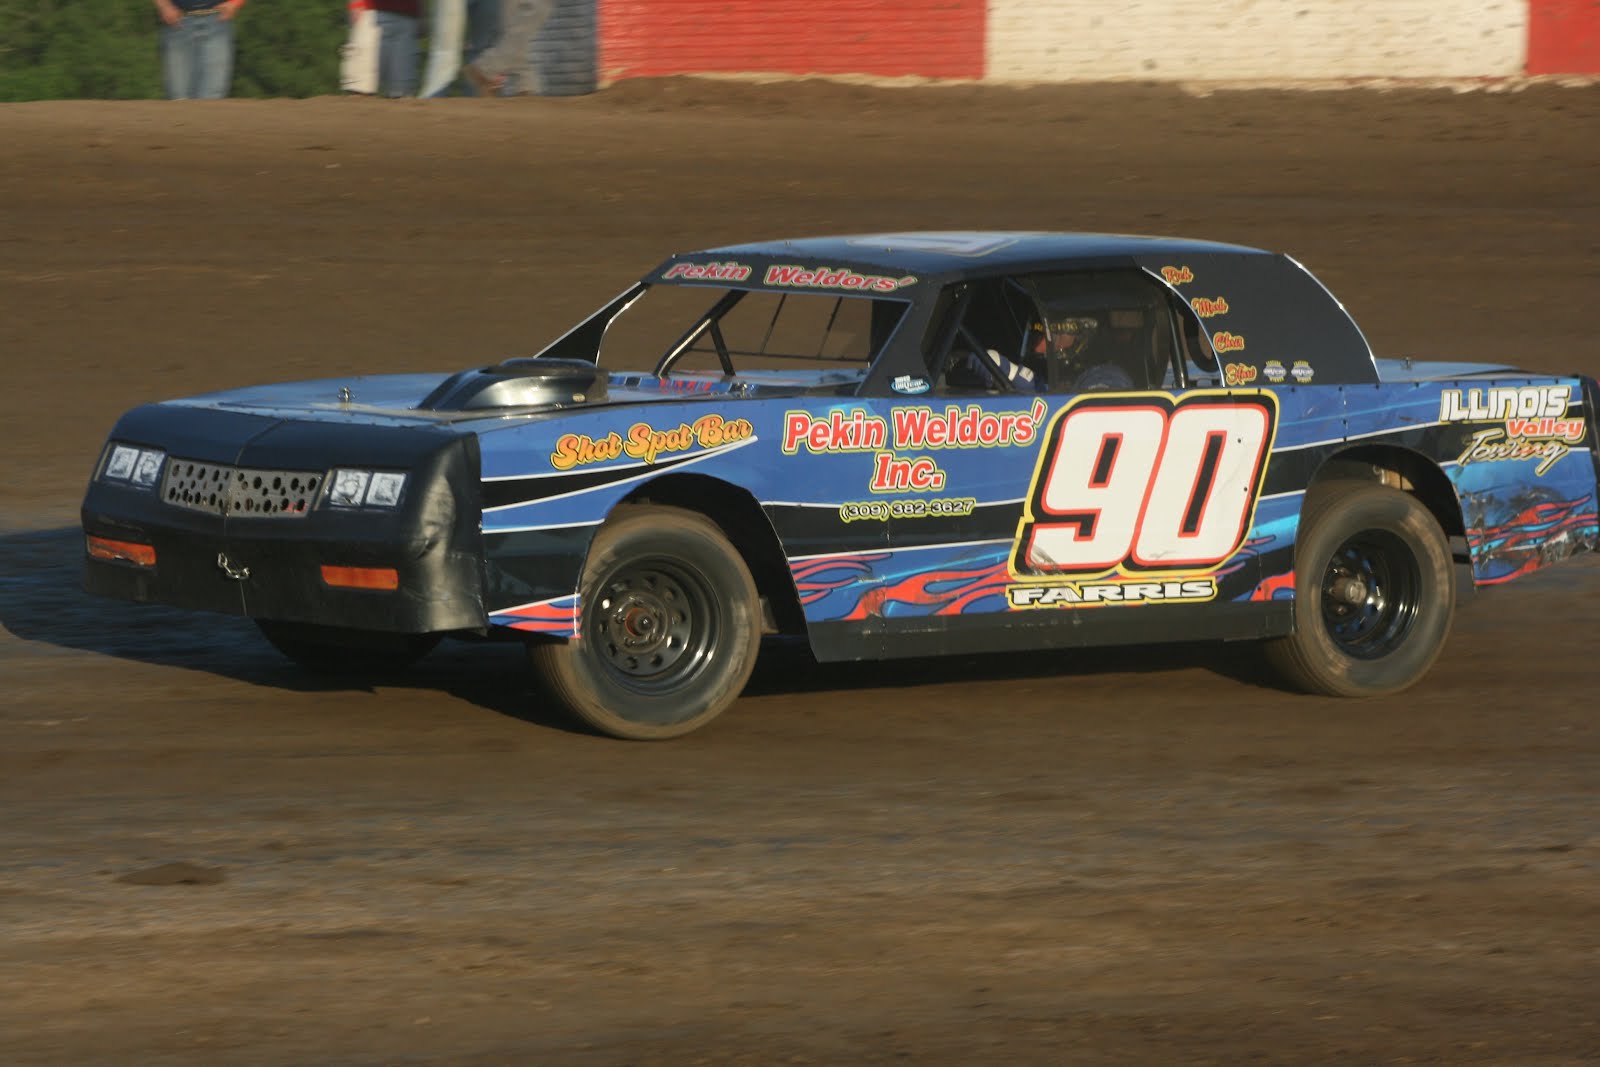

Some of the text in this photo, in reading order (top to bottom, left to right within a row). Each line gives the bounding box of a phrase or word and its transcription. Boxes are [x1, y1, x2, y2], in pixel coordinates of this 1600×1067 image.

[663, 263, 917, 291] Pekin Weldors'
[1440, 385, 1570, 421] ILLINOIS
[552, 414, 753, 469] Shot Spot Bar
[784, 398, 1046, 452] Pekin Weldors'
[1506, 418, 1585, 440] Valley
[1459, 429, 1568, 475] Towing
[871, 452, 945, 491] Inc.
[1026, 404, 1269, 570] 90
[841, 499, 975, 521] (309) 382-3627
[1011, 580, 1214, 605] FARRIS
